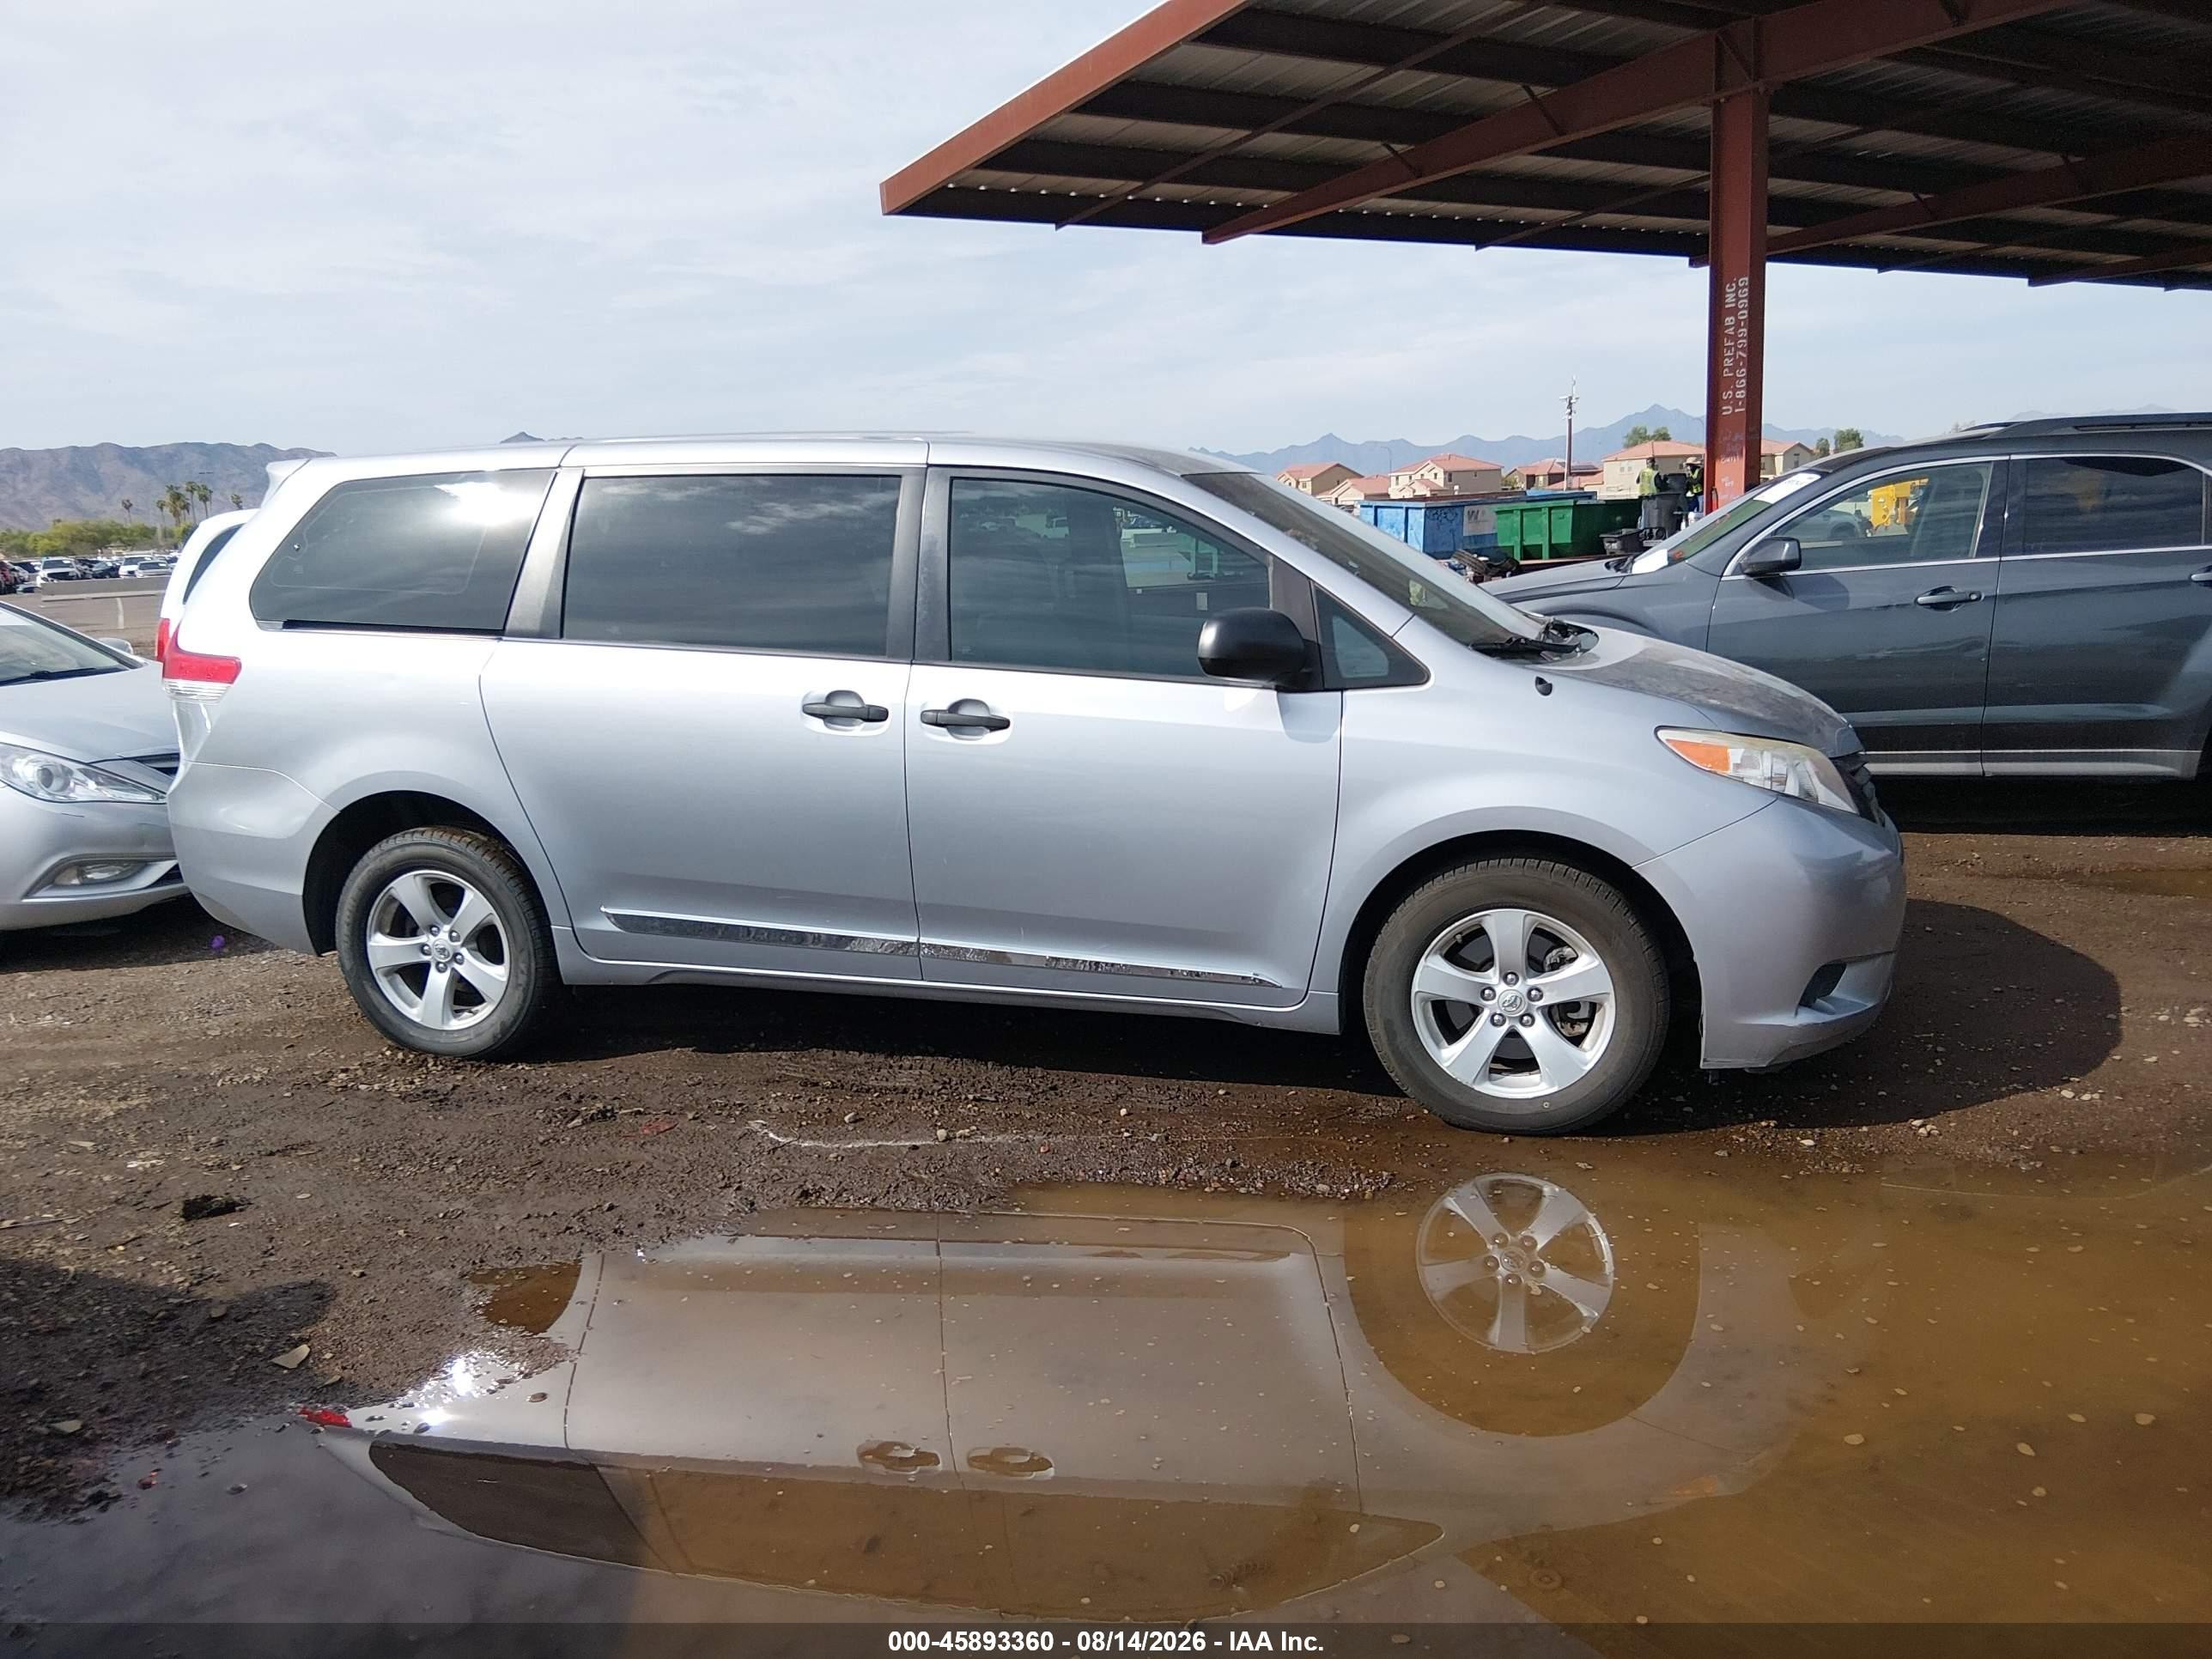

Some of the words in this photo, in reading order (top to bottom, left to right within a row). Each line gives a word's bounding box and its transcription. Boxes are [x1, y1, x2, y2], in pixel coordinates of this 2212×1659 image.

[1724, 277, 1736, 308] INC.
[1723, 316, 1735, 377] PREFAB
[1735, 276, 1748, 412] 1-866-799-0969
[1722, 385, 1733, 416] U.S.
